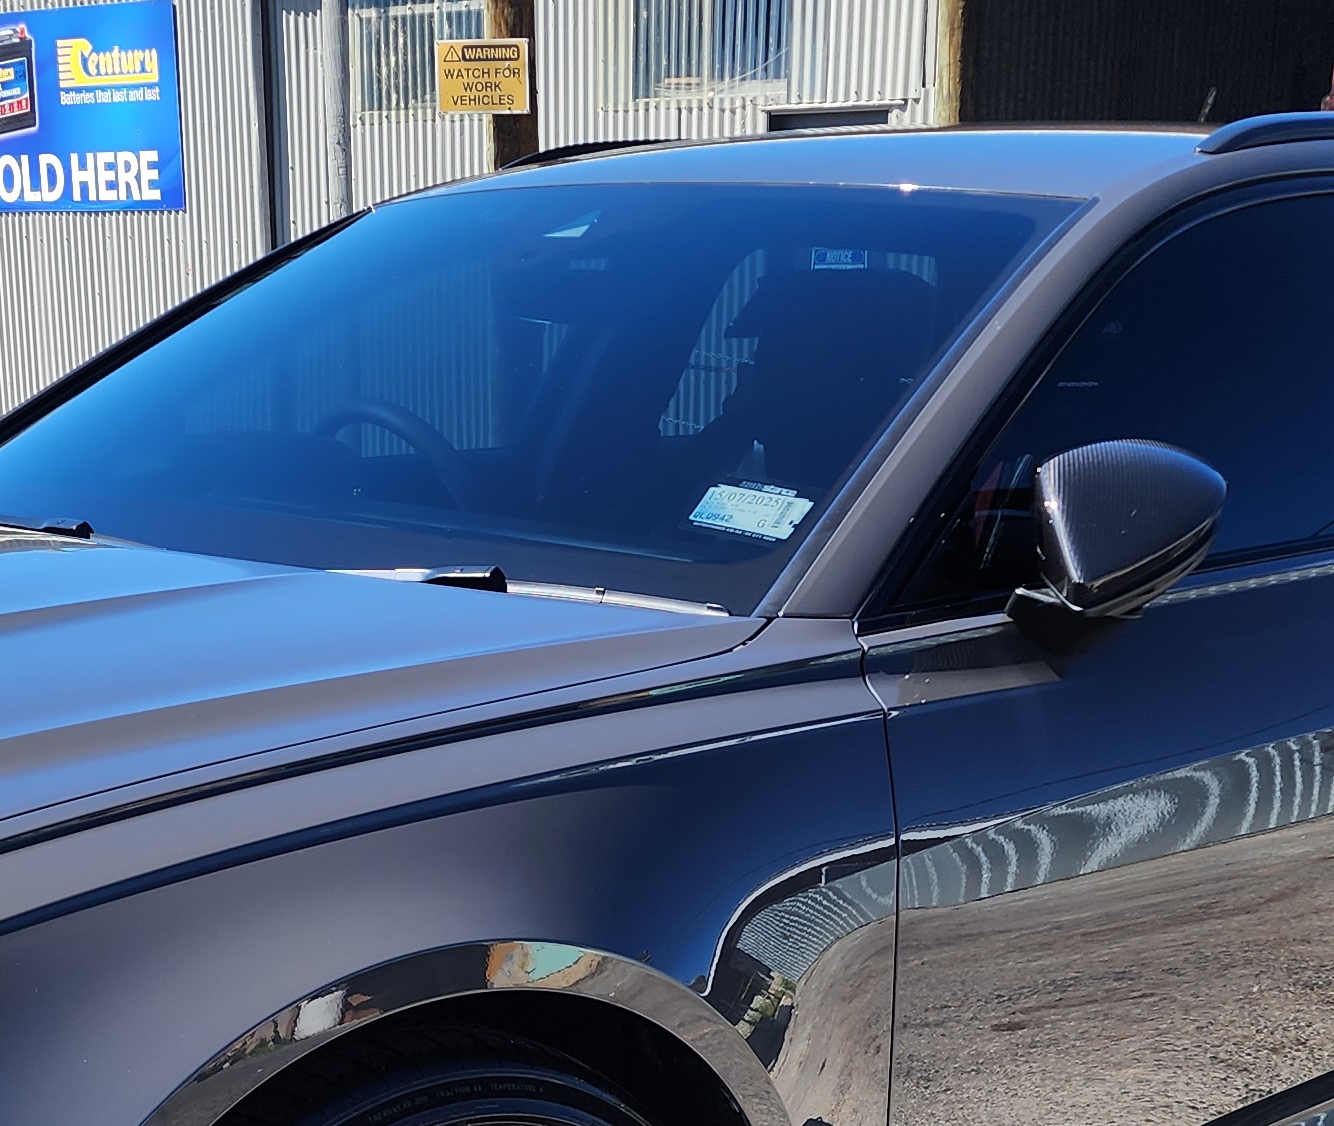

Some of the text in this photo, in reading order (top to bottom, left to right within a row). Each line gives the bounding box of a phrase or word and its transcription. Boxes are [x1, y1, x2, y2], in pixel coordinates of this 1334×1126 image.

[463, 46, 518, 60] WARNING
[56, 37, 159, 88] Century
[443, 67, 521, 80] WATCH FOR
[462, 81, 503, 93] WORK
[60, 86, 161, 105] Batteries that last and last
[451, 94, 515, 106] VEHICLES
[70, 150, 162, 202] HERE
[826, 250, 854, 263] NOTICE
[707, 490, 782, 508] 15/07/2025
[436, 1085, 471, 1098] TRACTION
[490, 1083, 537, 1093] TEMPERATURE
[368, 1100, 412, 1124] TREADWEAR
